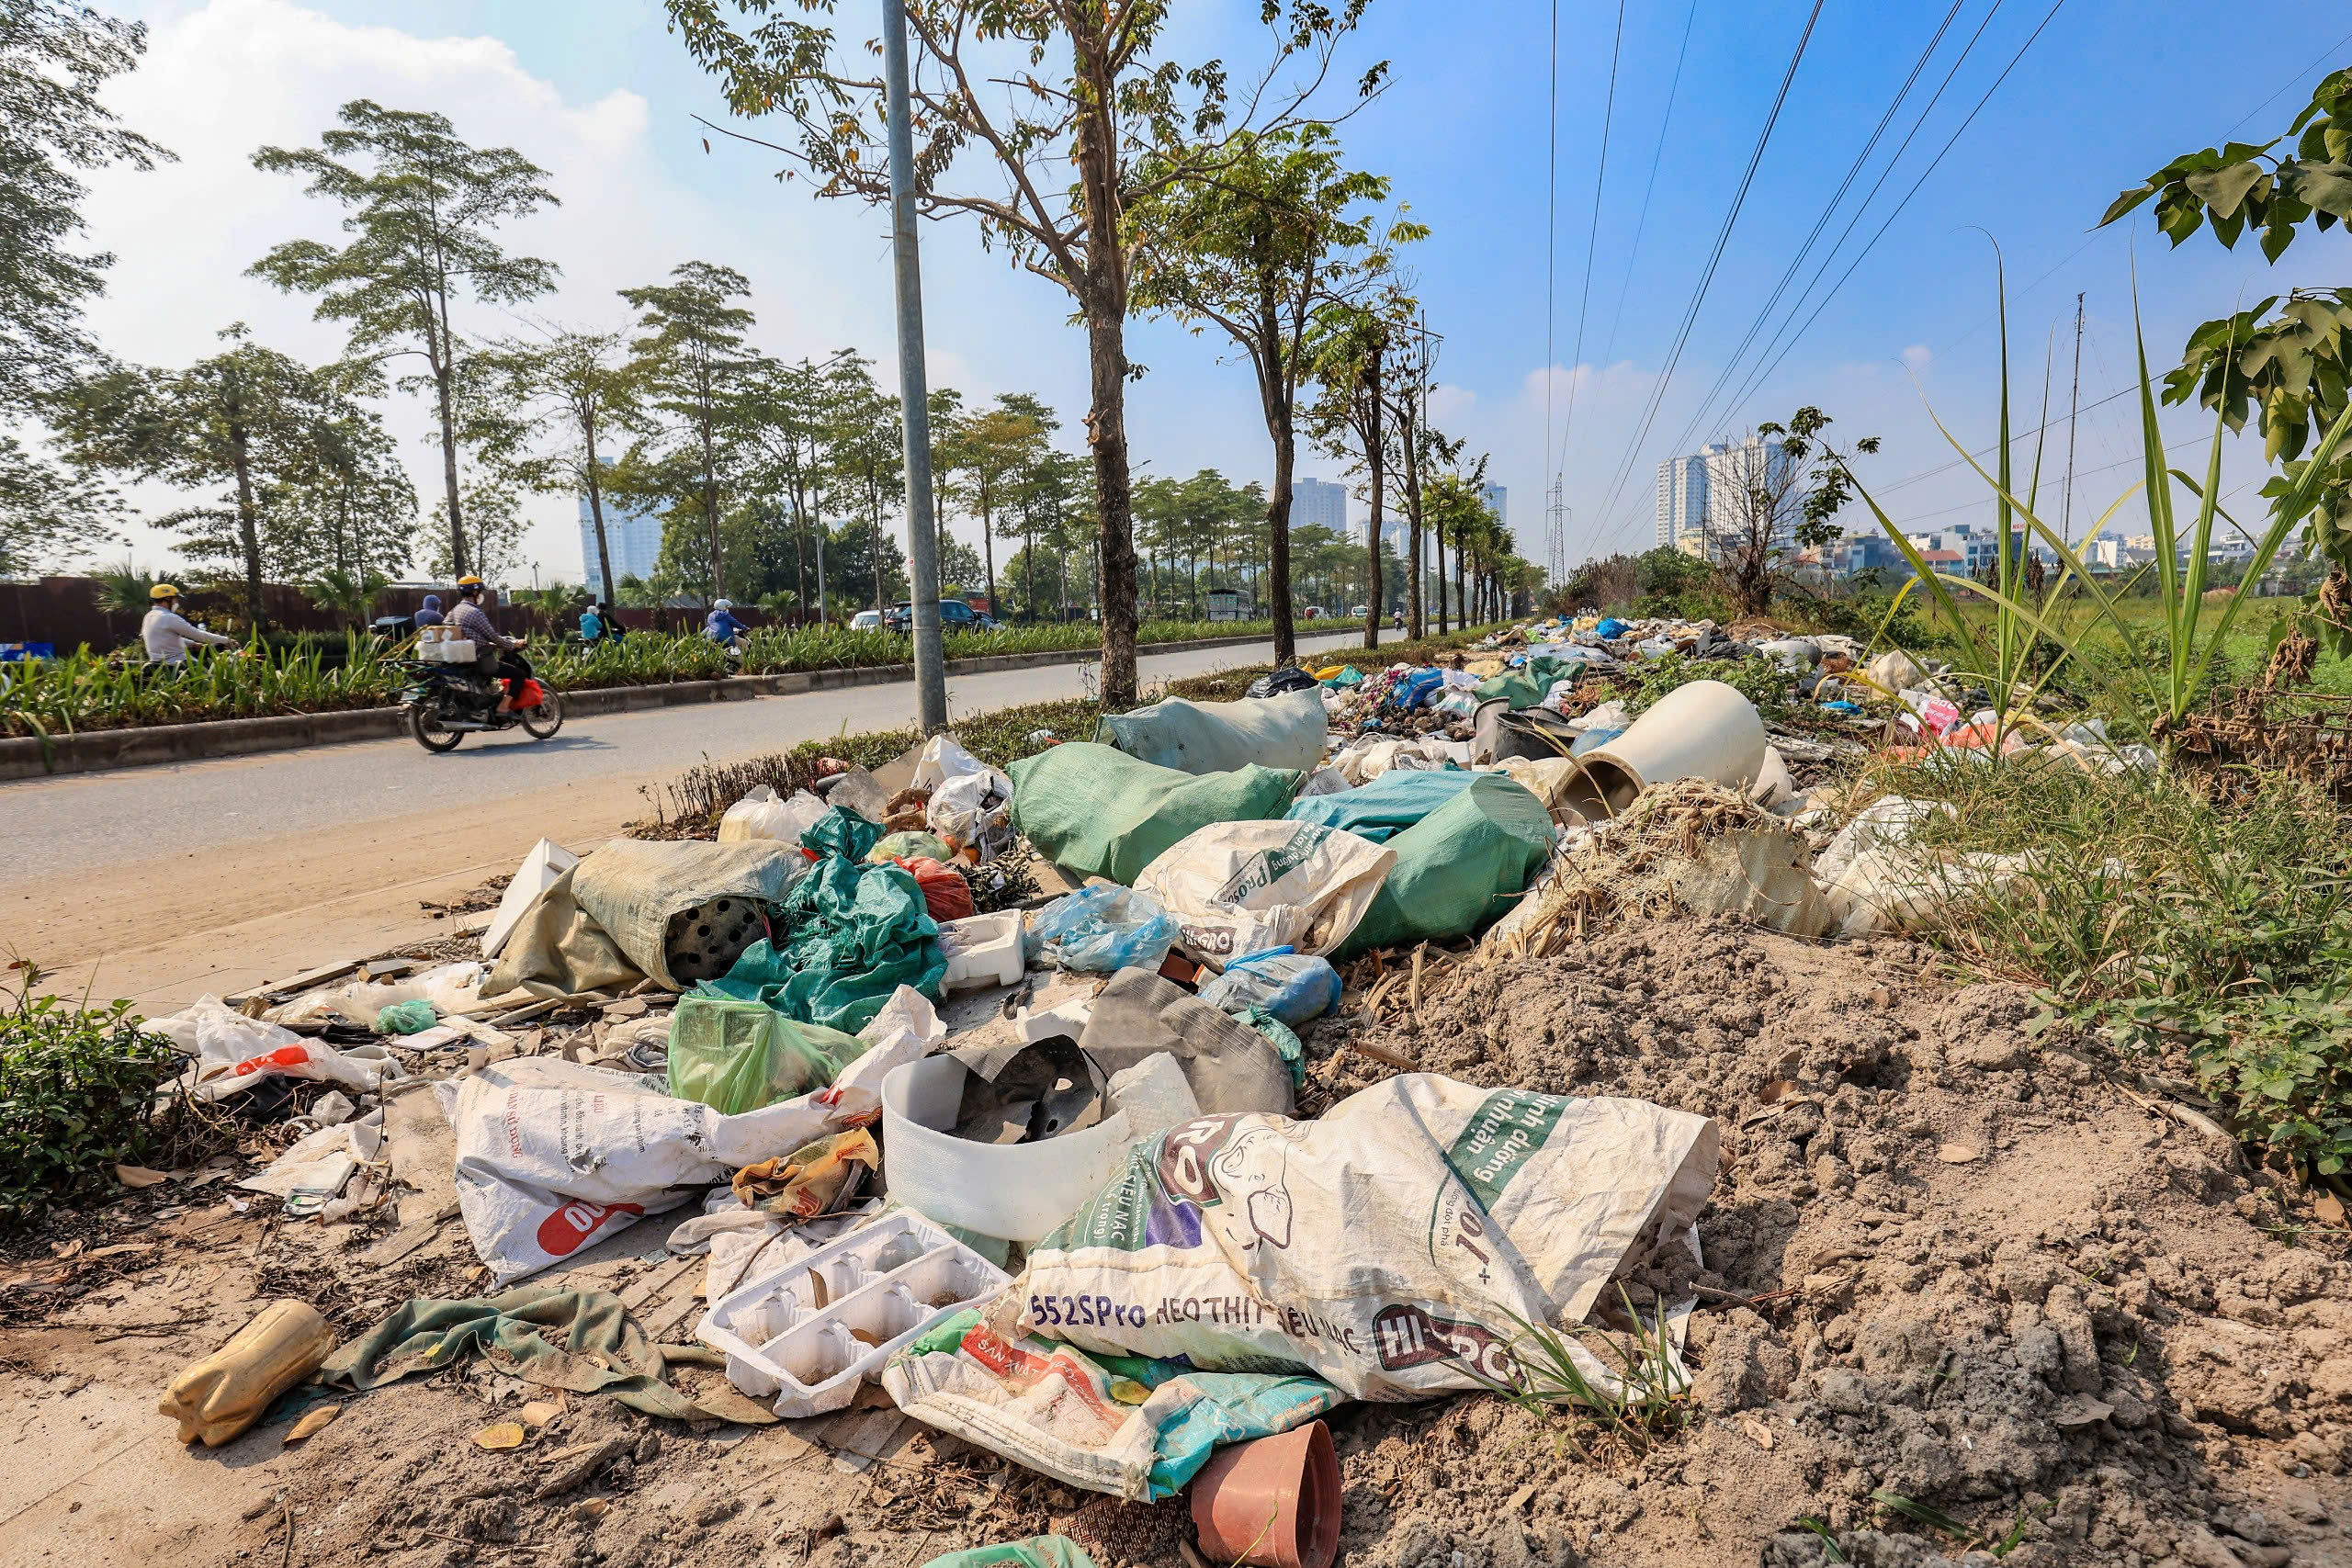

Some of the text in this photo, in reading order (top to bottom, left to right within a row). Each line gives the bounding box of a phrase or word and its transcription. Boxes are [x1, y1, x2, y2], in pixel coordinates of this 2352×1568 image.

[1466, 1096, 1515, 1156] nhuận
[1474, 1128, 1532, 1183] dưỡng
[1118, 1174, 1136, 1207] SIÊU
[1109, 1210, 1130, 1241] NẠC
[1030, 1294, 1146, 1328] 552SPro
[1156, 1297, 1200, 1325] HEO
[1203, 1296, 1263, 1331] THỊT
[1319, 1316, 1361, 1357] NẠC
